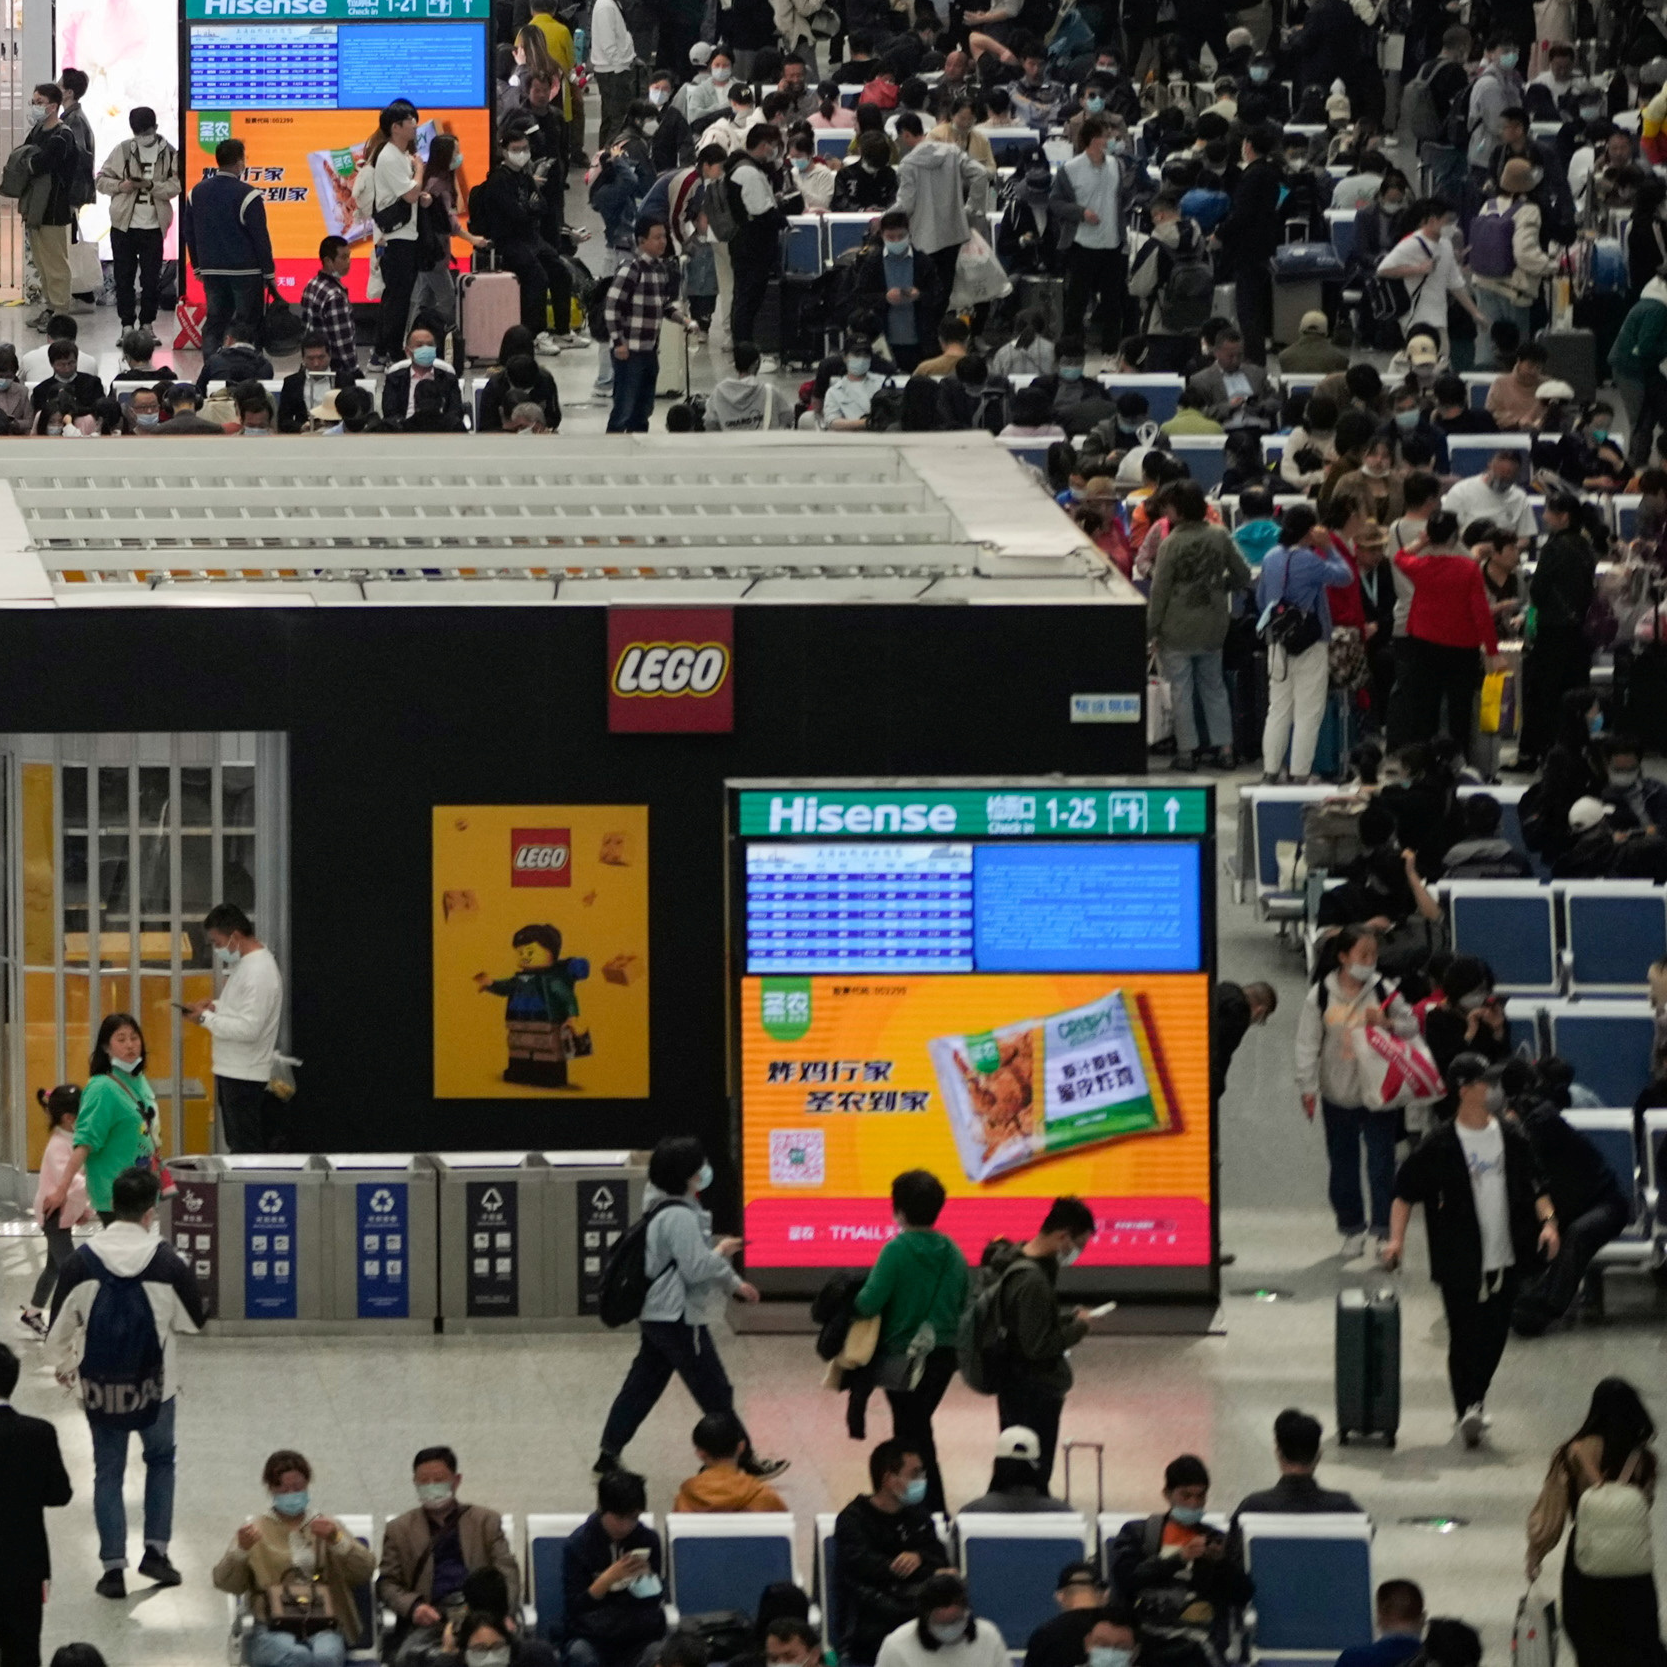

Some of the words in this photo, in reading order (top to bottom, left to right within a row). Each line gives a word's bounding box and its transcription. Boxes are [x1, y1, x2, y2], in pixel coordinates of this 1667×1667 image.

[348, 8, 367, 16] Check
[199, 121, 230, 137] 圣农
[617, 645, 728, 695] LEGO
[768, 796, 958, 834] Hisense
[986, 795, 1036, 822] 检票口
[1046, 798, 1098, 830] 1-25
[515, 844, 570, 872] LEGO
[763, 991, 810, 1016] 圣农
[768, 1060, 893, 1084] 炸鸡行家
[1057, 1067, 1134, 1105] 脆皮炸鸡
[805, 1090, 930, 1114] 圣农到家
